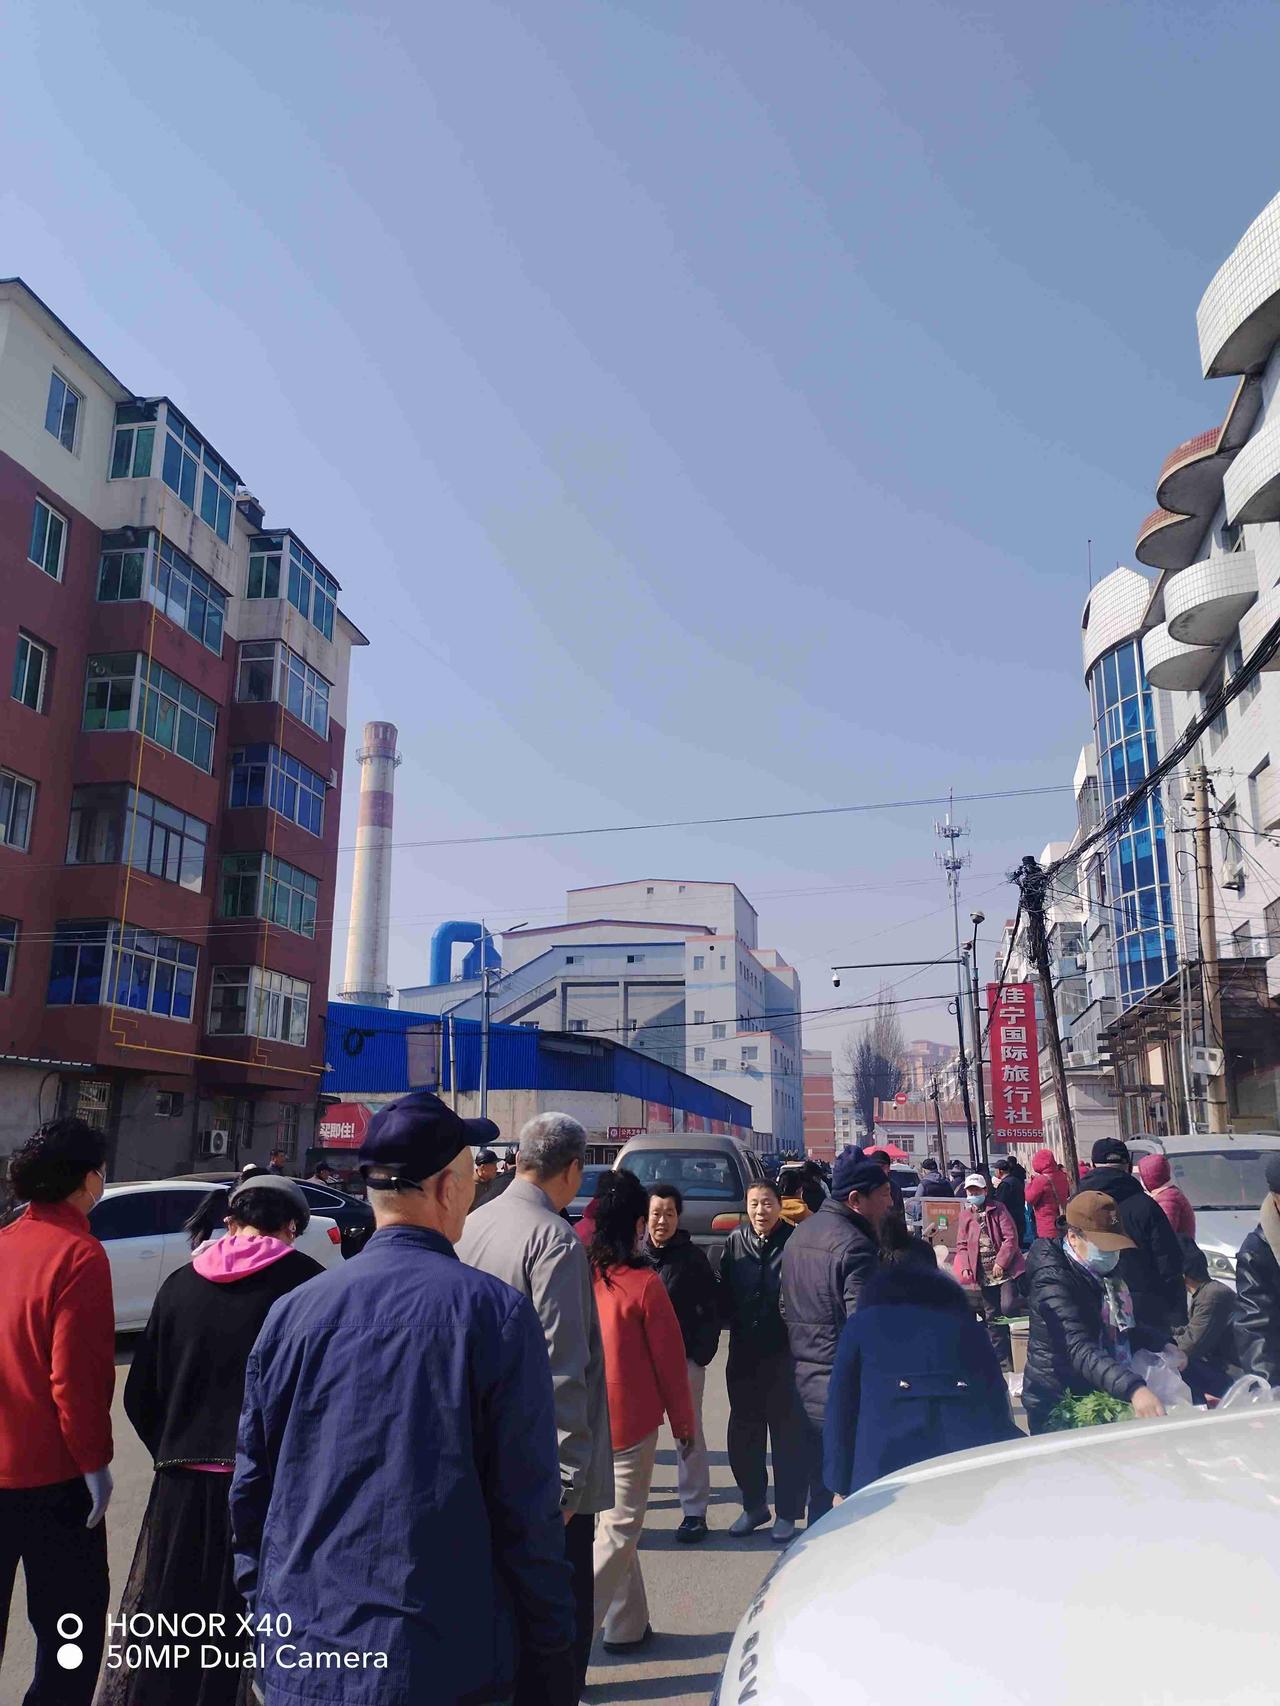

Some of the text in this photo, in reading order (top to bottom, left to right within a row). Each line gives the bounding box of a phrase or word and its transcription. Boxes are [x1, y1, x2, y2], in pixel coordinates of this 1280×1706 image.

[999, 987, 1034, 1124] 佳宁国际旅行社
[1007, 1129, 1043, 1137] 6155555
